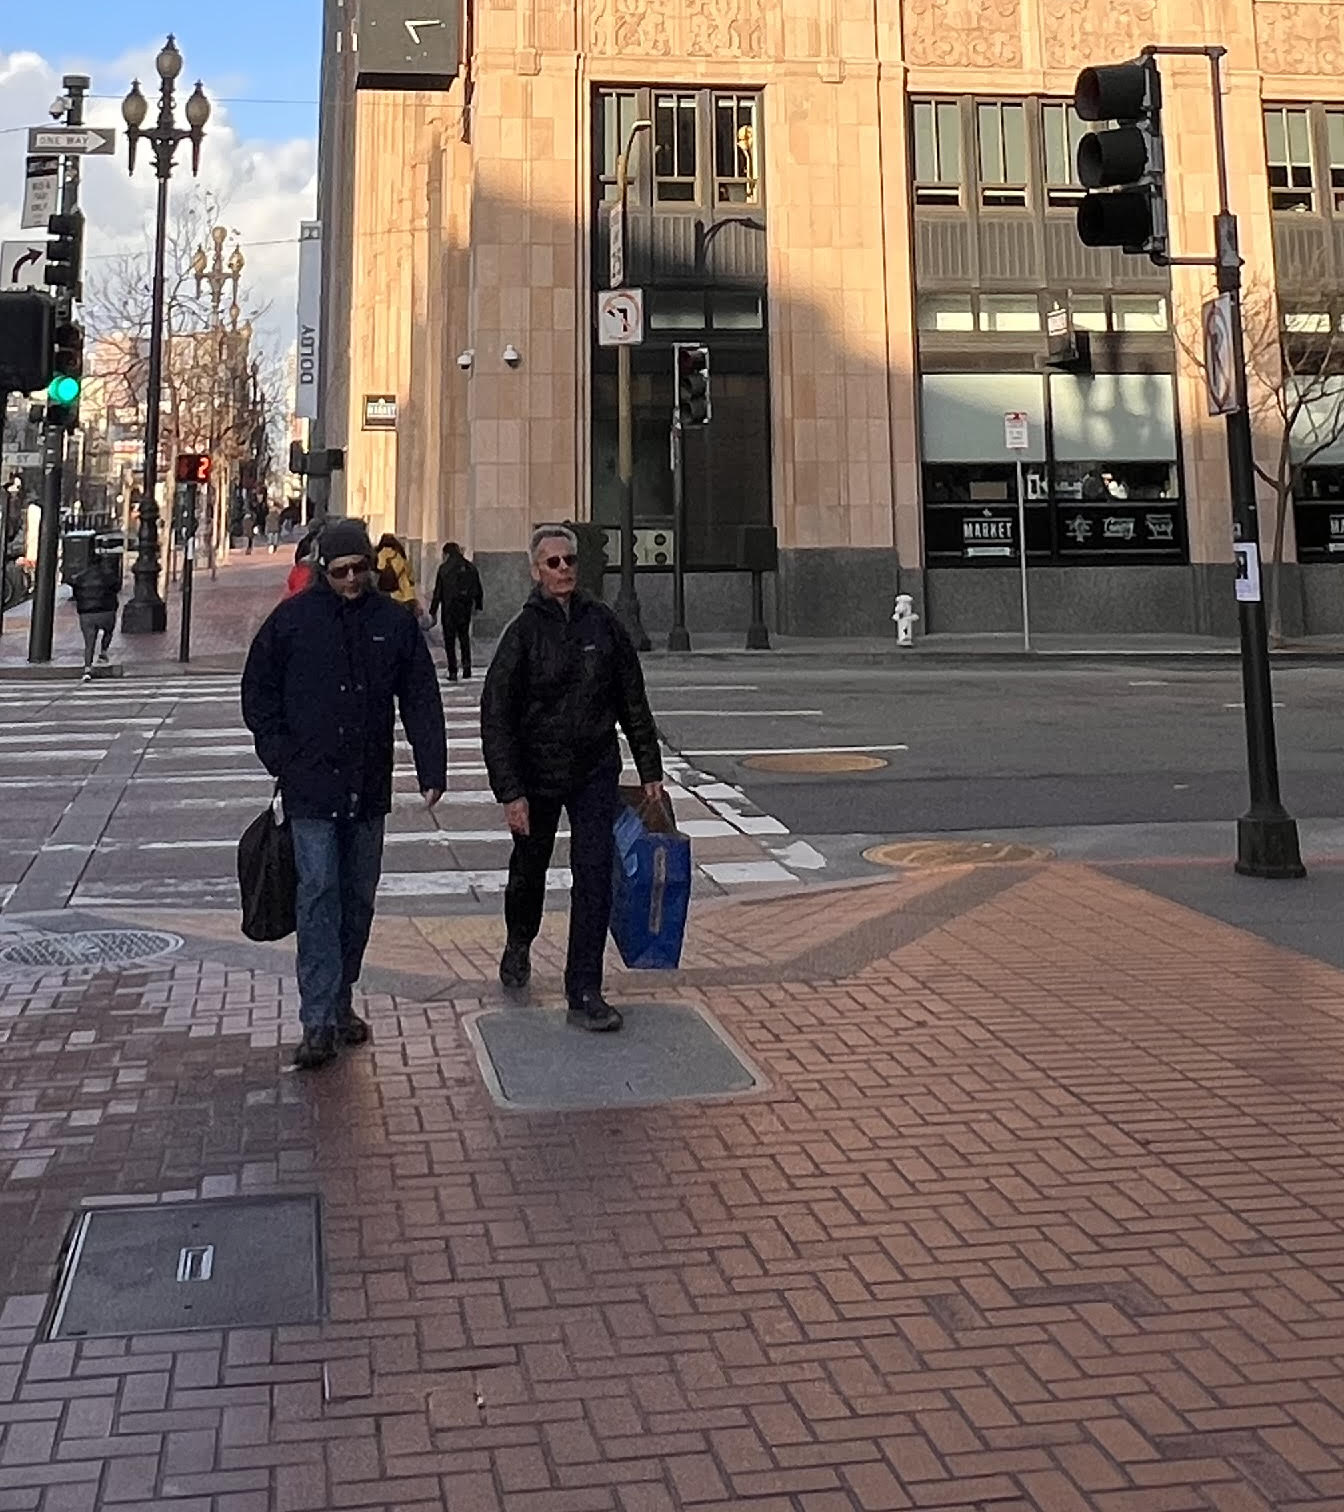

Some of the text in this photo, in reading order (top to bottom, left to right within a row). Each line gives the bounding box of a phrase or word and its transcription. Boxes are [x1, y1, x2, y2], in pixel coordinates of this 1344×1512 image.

[39, 135, 89, 145] ONE WAY
[197, 457, 209, 478] 2
[963, 522, 1012, 538] MARKET
